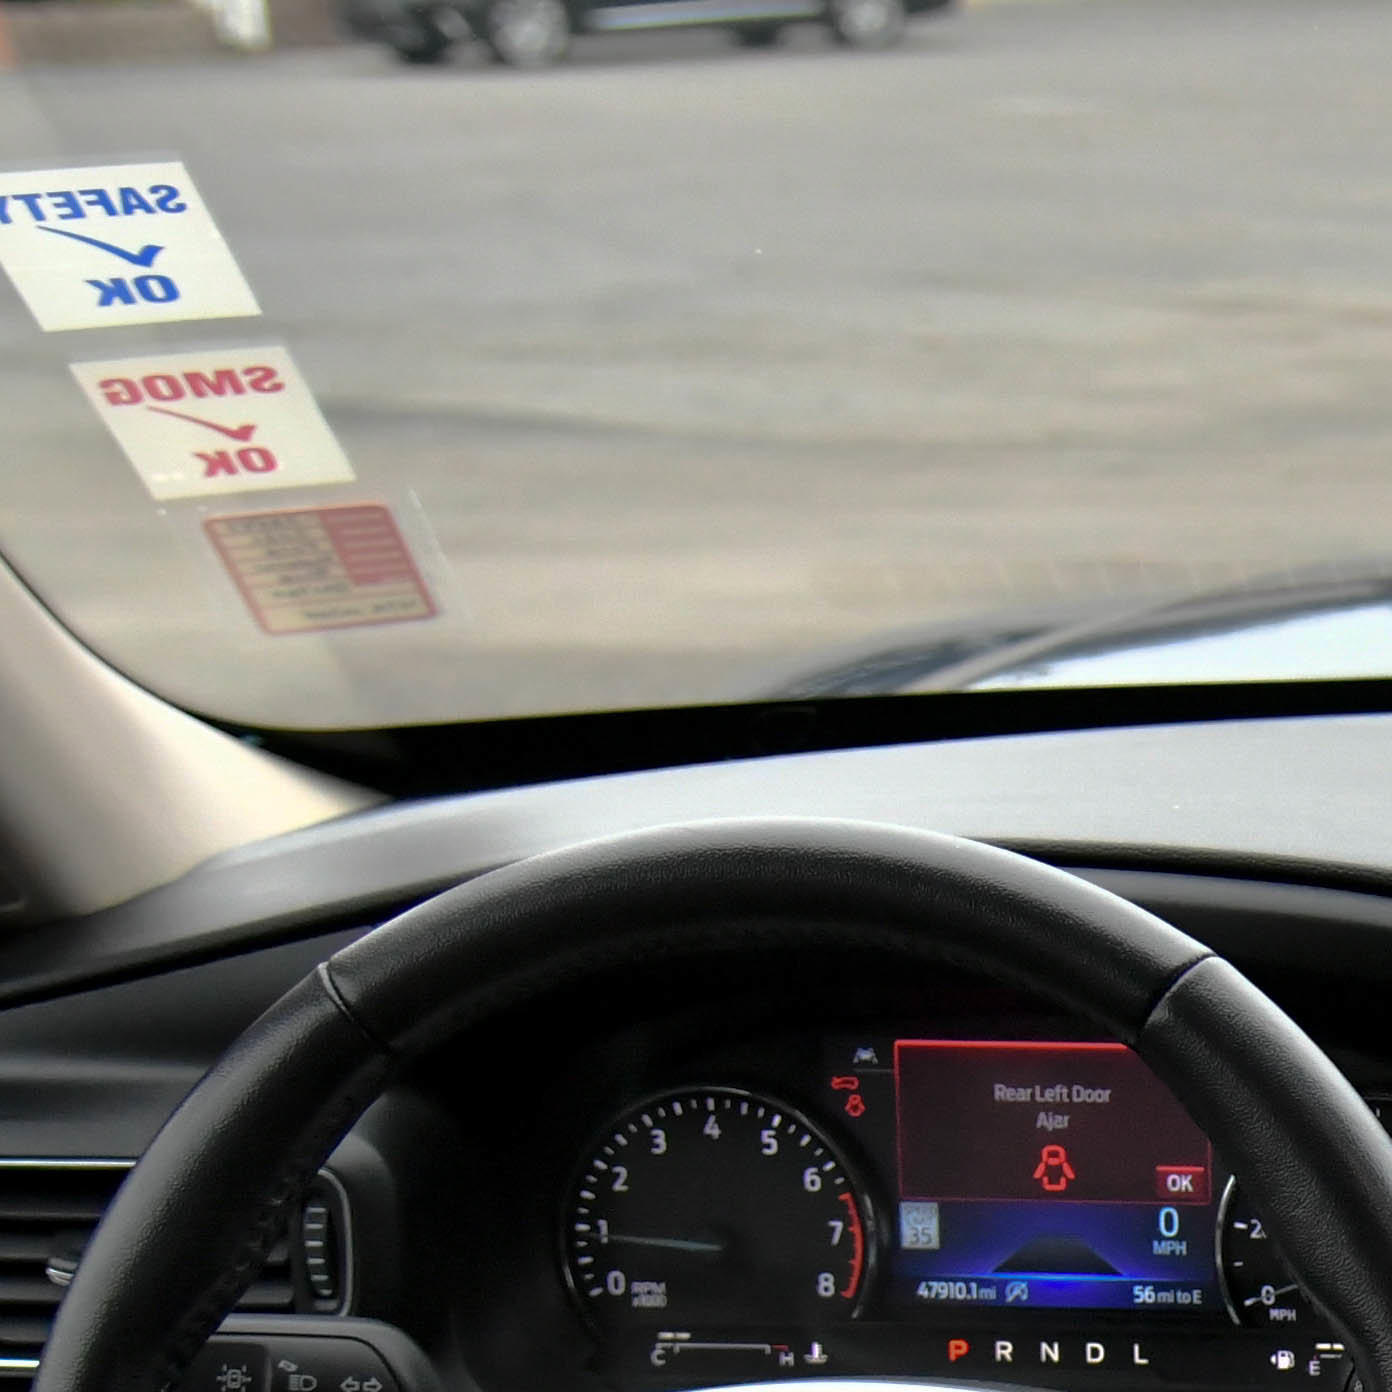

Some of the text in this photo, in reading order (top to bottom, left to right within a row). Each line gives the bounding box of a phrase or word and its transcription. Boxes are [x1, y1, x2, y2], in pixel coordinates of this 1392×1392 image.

[993, 1083, 1112, 1103] Rear Left Door
[703, 1116, 721, 1139] 4
[1036, 1111, 1070, 1131] Ajar
[650, 1130, 668, 1155] 3
[761, 1130, 778, 1155] 5
[612, 1167, 629, 1191] 2
[803, 1167, 821, 1191] 6
[1166, 1174, 1194, 1192] OK
[1159, 1206, 1179, 1238] 0
[828, 1221, 843, 1245] 7
[911, 1226, 933, 1245] 35
[1152, 1240, 1188, 1256] MPH
[607, 1270, 626, 1296] 0
[817, 1273, 834, 1297] 8
[917, 1281, 977, 1300] 47910.1
[1133, 1285, 1156, 1304] 56
[1261, 1285, 1276, 1305] 0
[1269, 1308, 1297, 1322] MPH
[779, 1351, 795, 1367] H
[948, 1339, 1149, 1364] P R N D L
[1309, 1361, 1321, 1376] E
